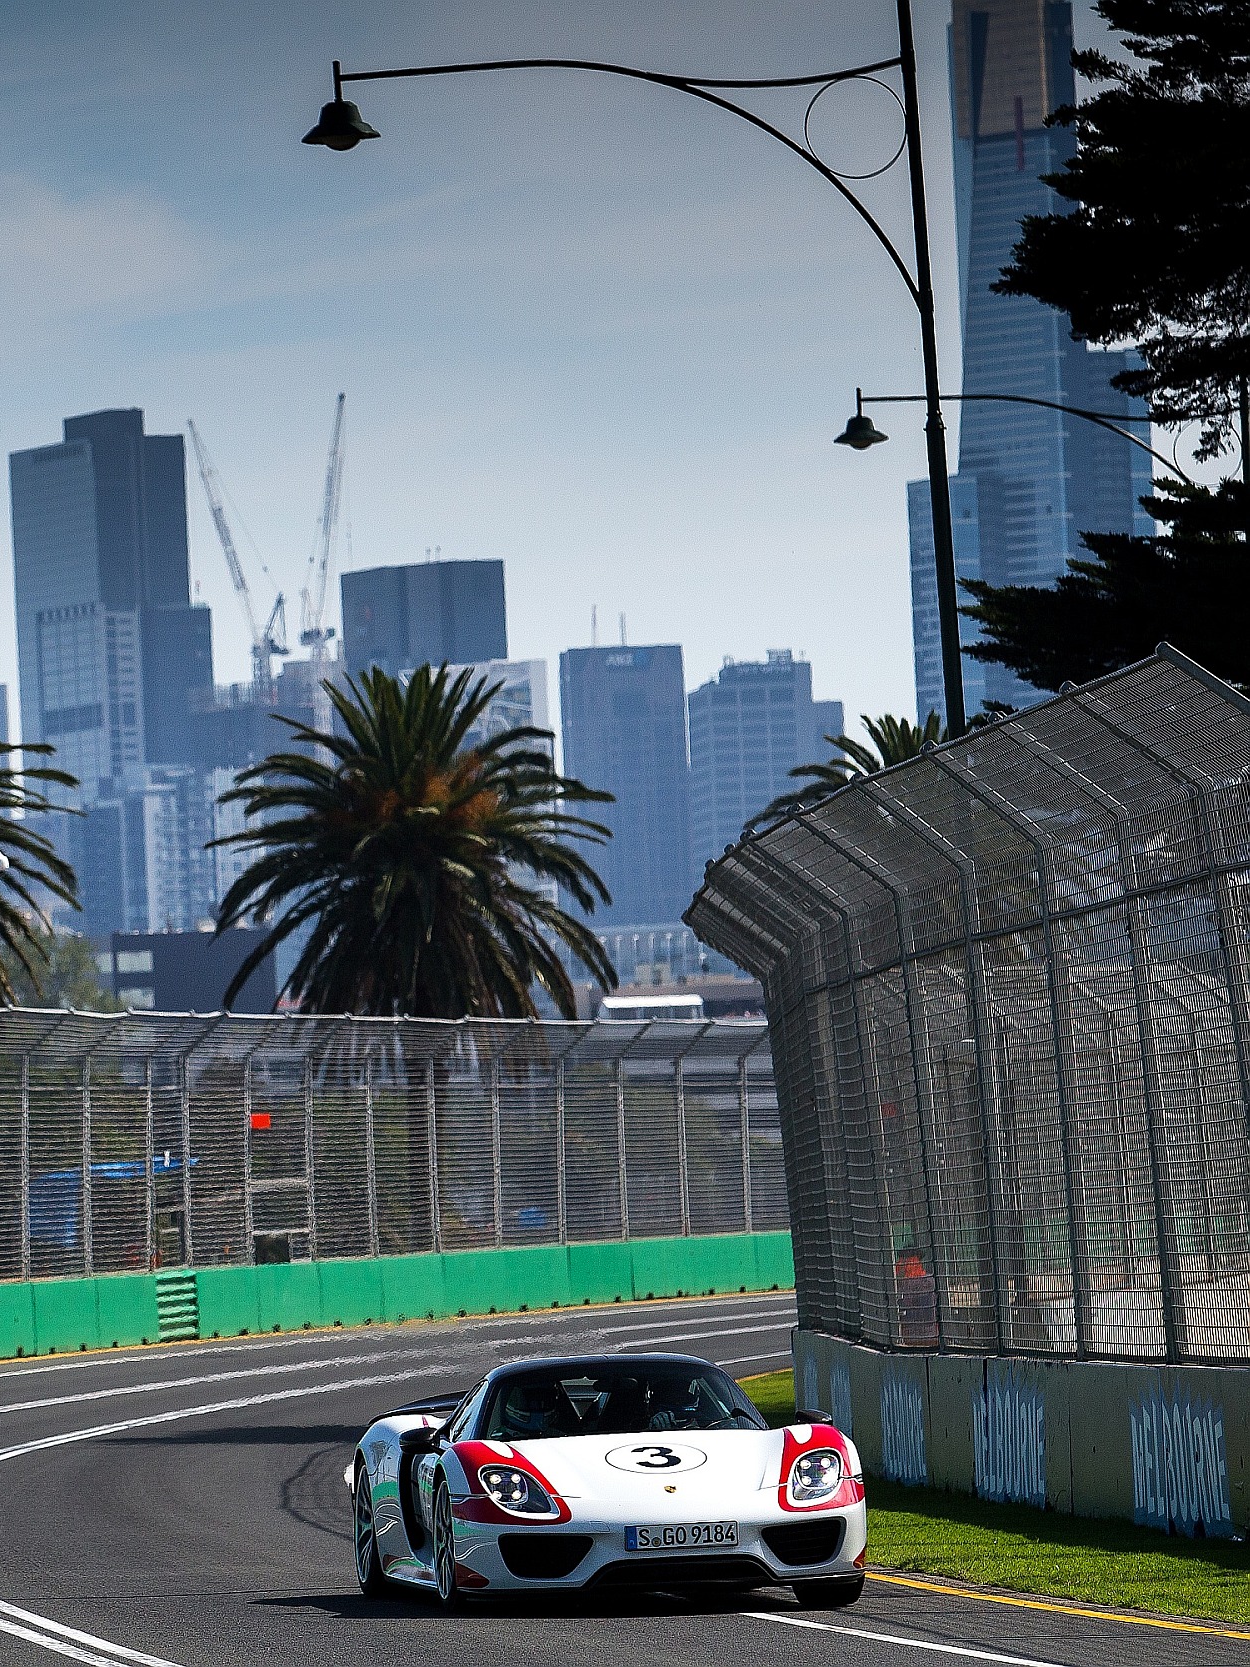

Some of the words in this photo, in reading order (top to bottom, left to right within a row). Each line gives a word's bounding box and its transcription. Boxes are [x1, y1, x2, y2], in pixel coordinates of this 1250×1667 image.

[631, 1447, 682, 1468] 3
[1130, 1401, 1231, 1523] MELBOURNE
[663, 1527, 687, 1546] GO
[692, 1524, 735, 1544] 9184
